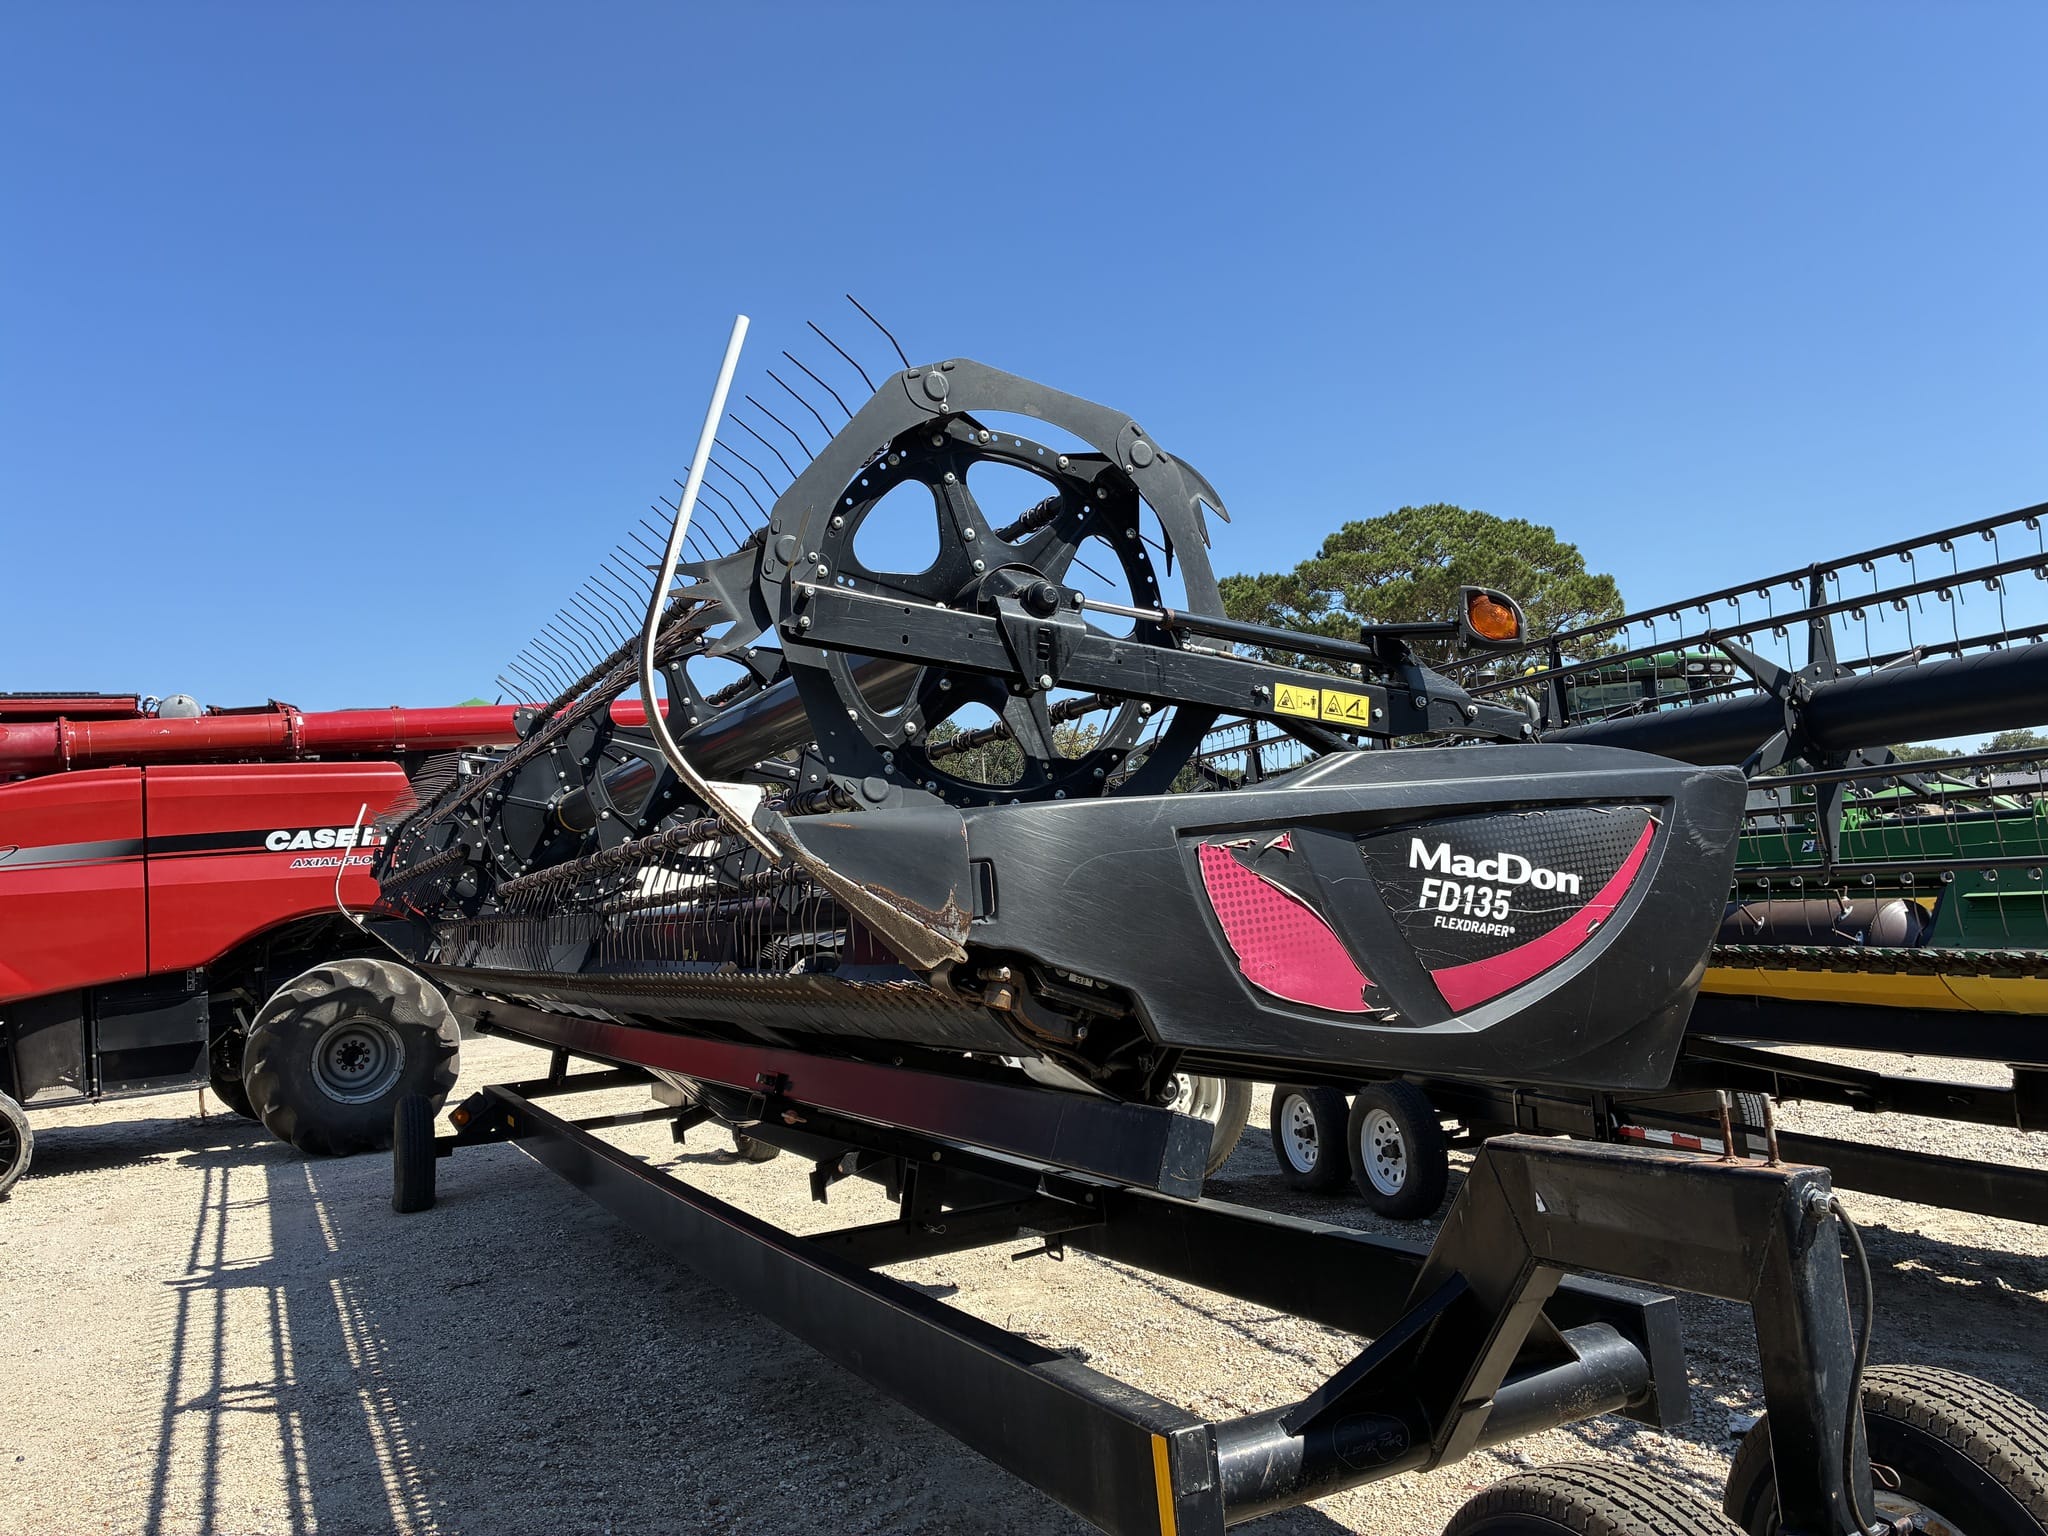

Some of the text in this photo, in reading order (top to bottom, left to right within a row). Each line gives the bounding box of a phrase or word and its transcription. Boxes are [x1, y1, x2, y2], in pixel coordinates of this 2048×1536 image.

[265, 828, 358, 851] CASE
[290, 854, 373, 869] AXIAL-FLO
[1409, 837, 1581, 895] MacDon
[1419, 877, 1512, 921] FD135
